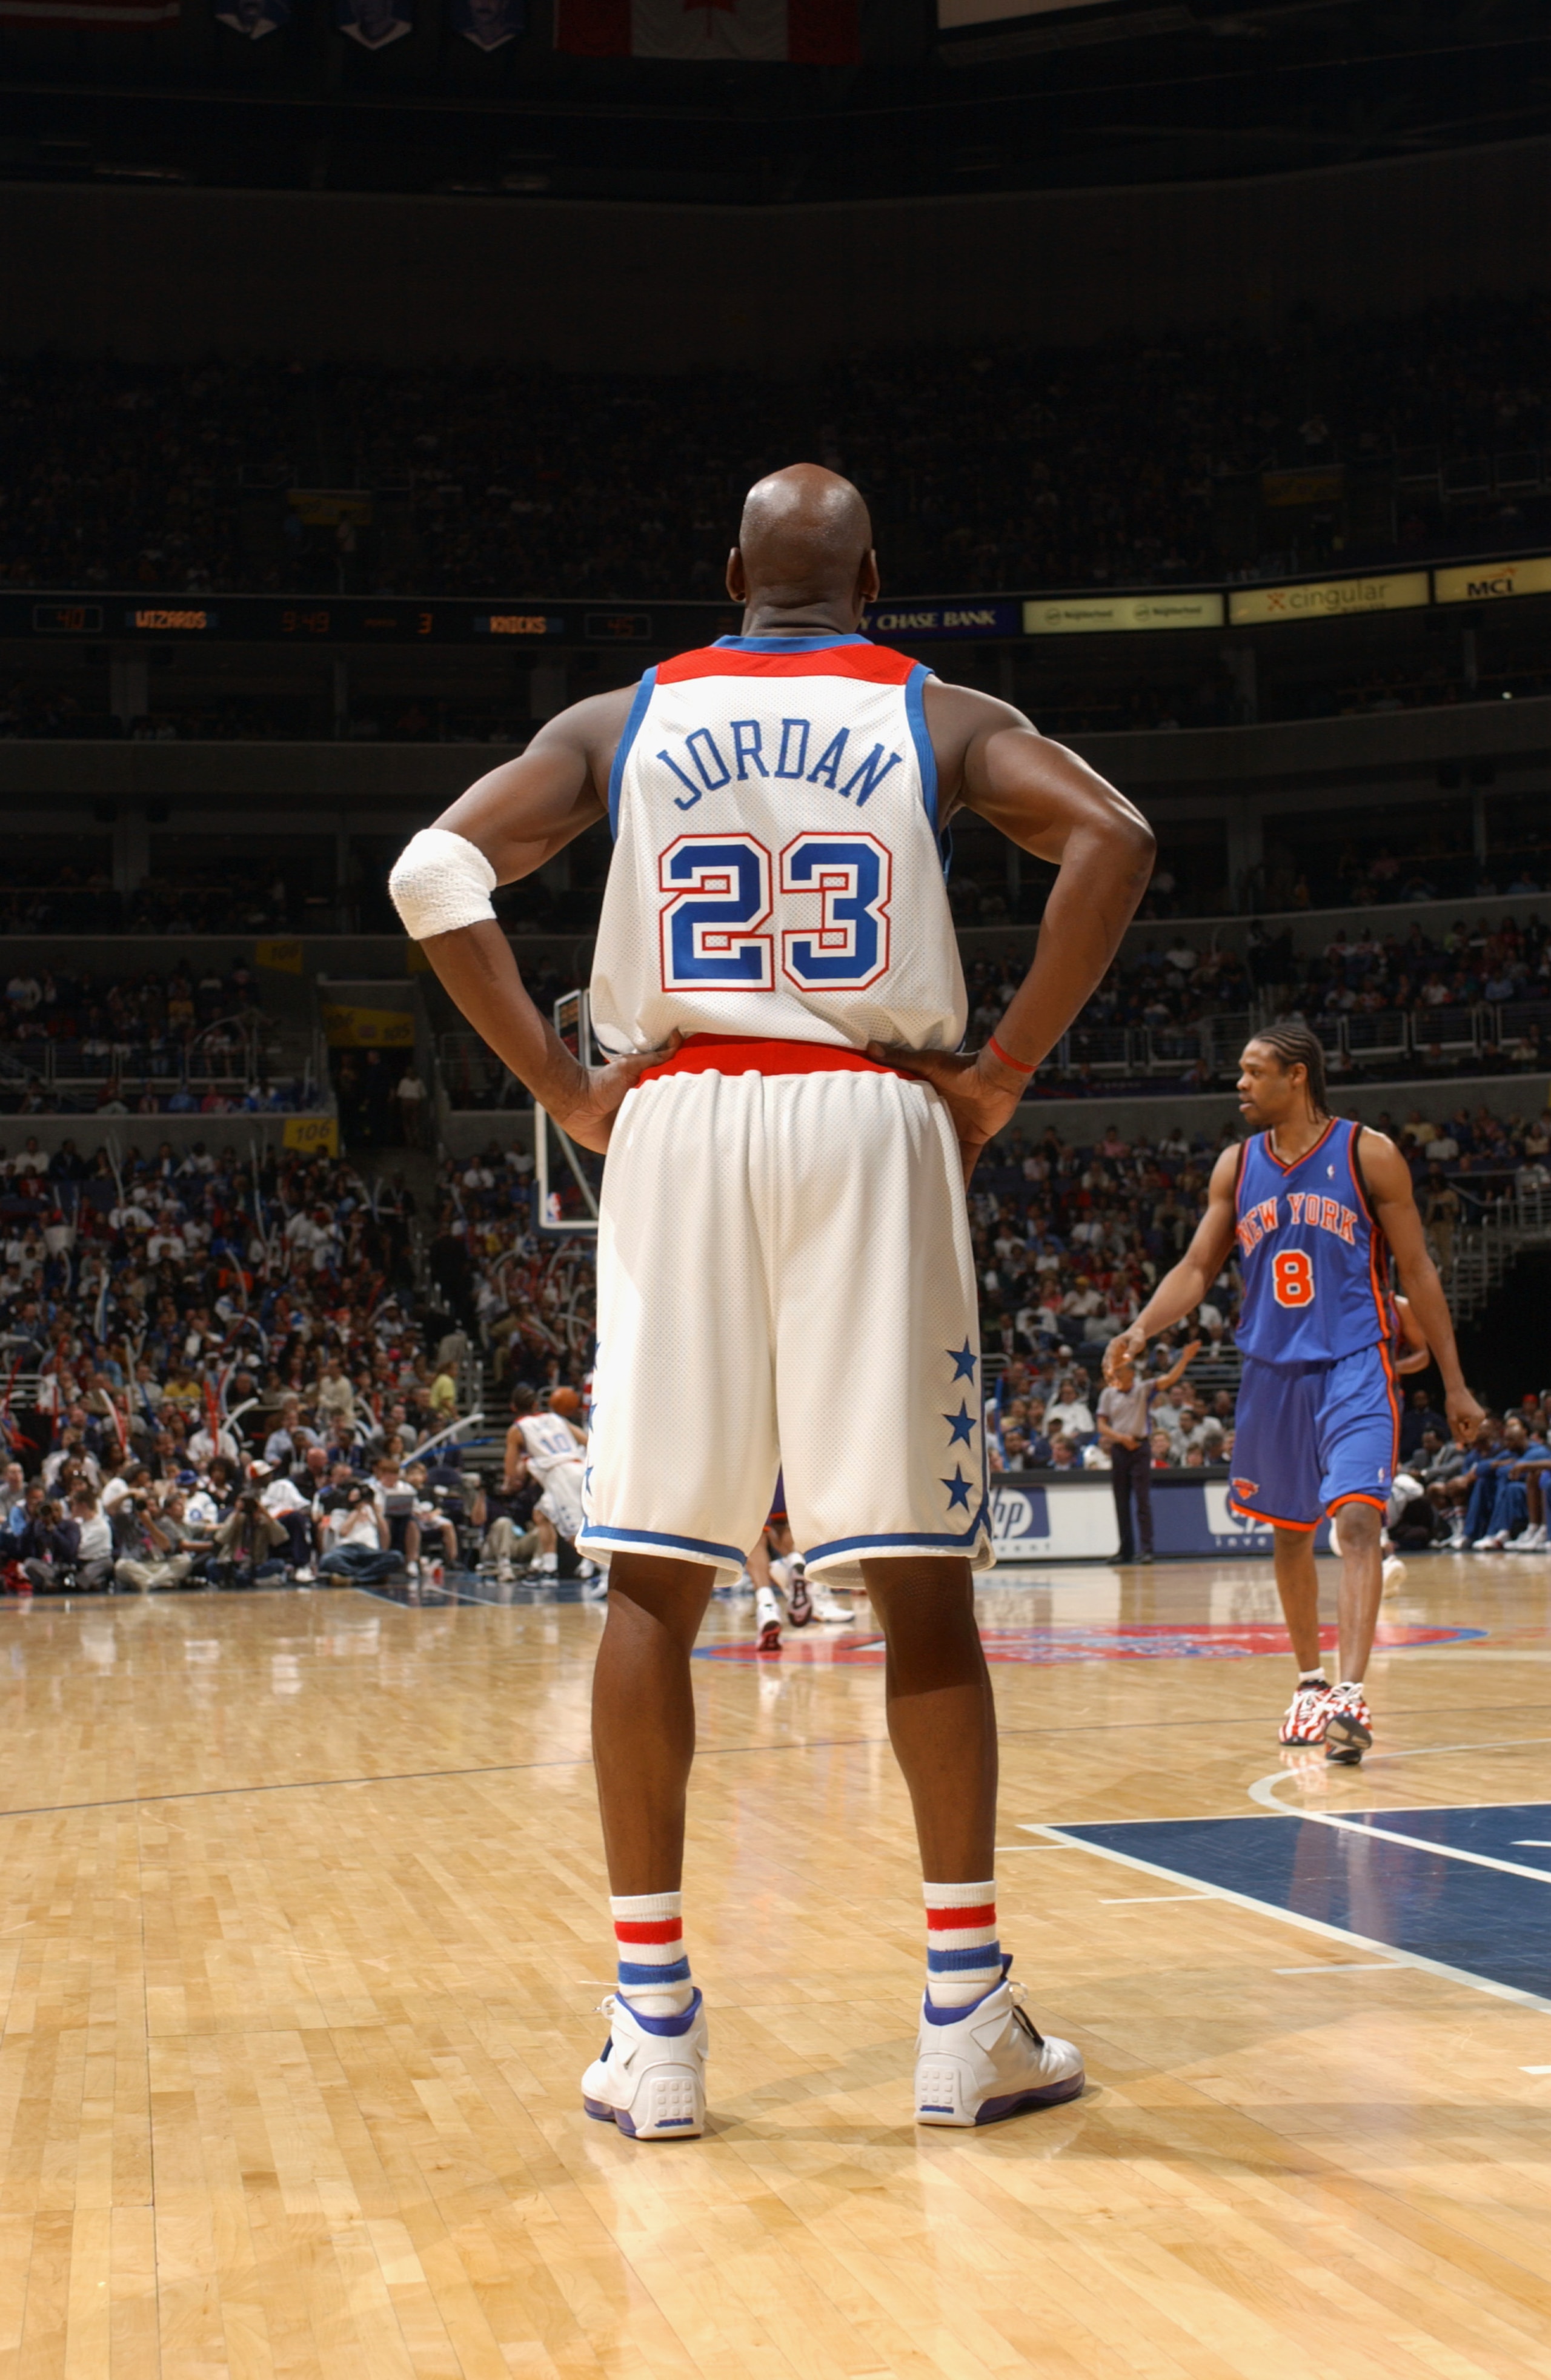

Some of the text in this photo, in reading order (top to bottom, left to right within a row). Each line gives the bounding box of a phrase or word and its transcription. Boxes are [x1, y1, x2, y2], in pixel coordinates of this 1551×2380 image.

[1289, 579, 1386, 611] cingular
[1467, 578, 1512, 596] MCI
[135, 609, 207, 630] WIZARDS
[417, 612, 434, 634] 3
[490, 615, 546, 634] KNICKS
[876, 612, 939, 631] CHASE
[943, 609, 997, 628] BANK
[656, 718, 902, 810] JORDAN
[659, 832, 892, 992] 23
[1236, 1192, 1358, 1257] NEW YORK
[1272, 1248, 1315, 1308] 8
[540, 1433, 571, 1454] 10
[993, 1487, 1024, 1539] hp
